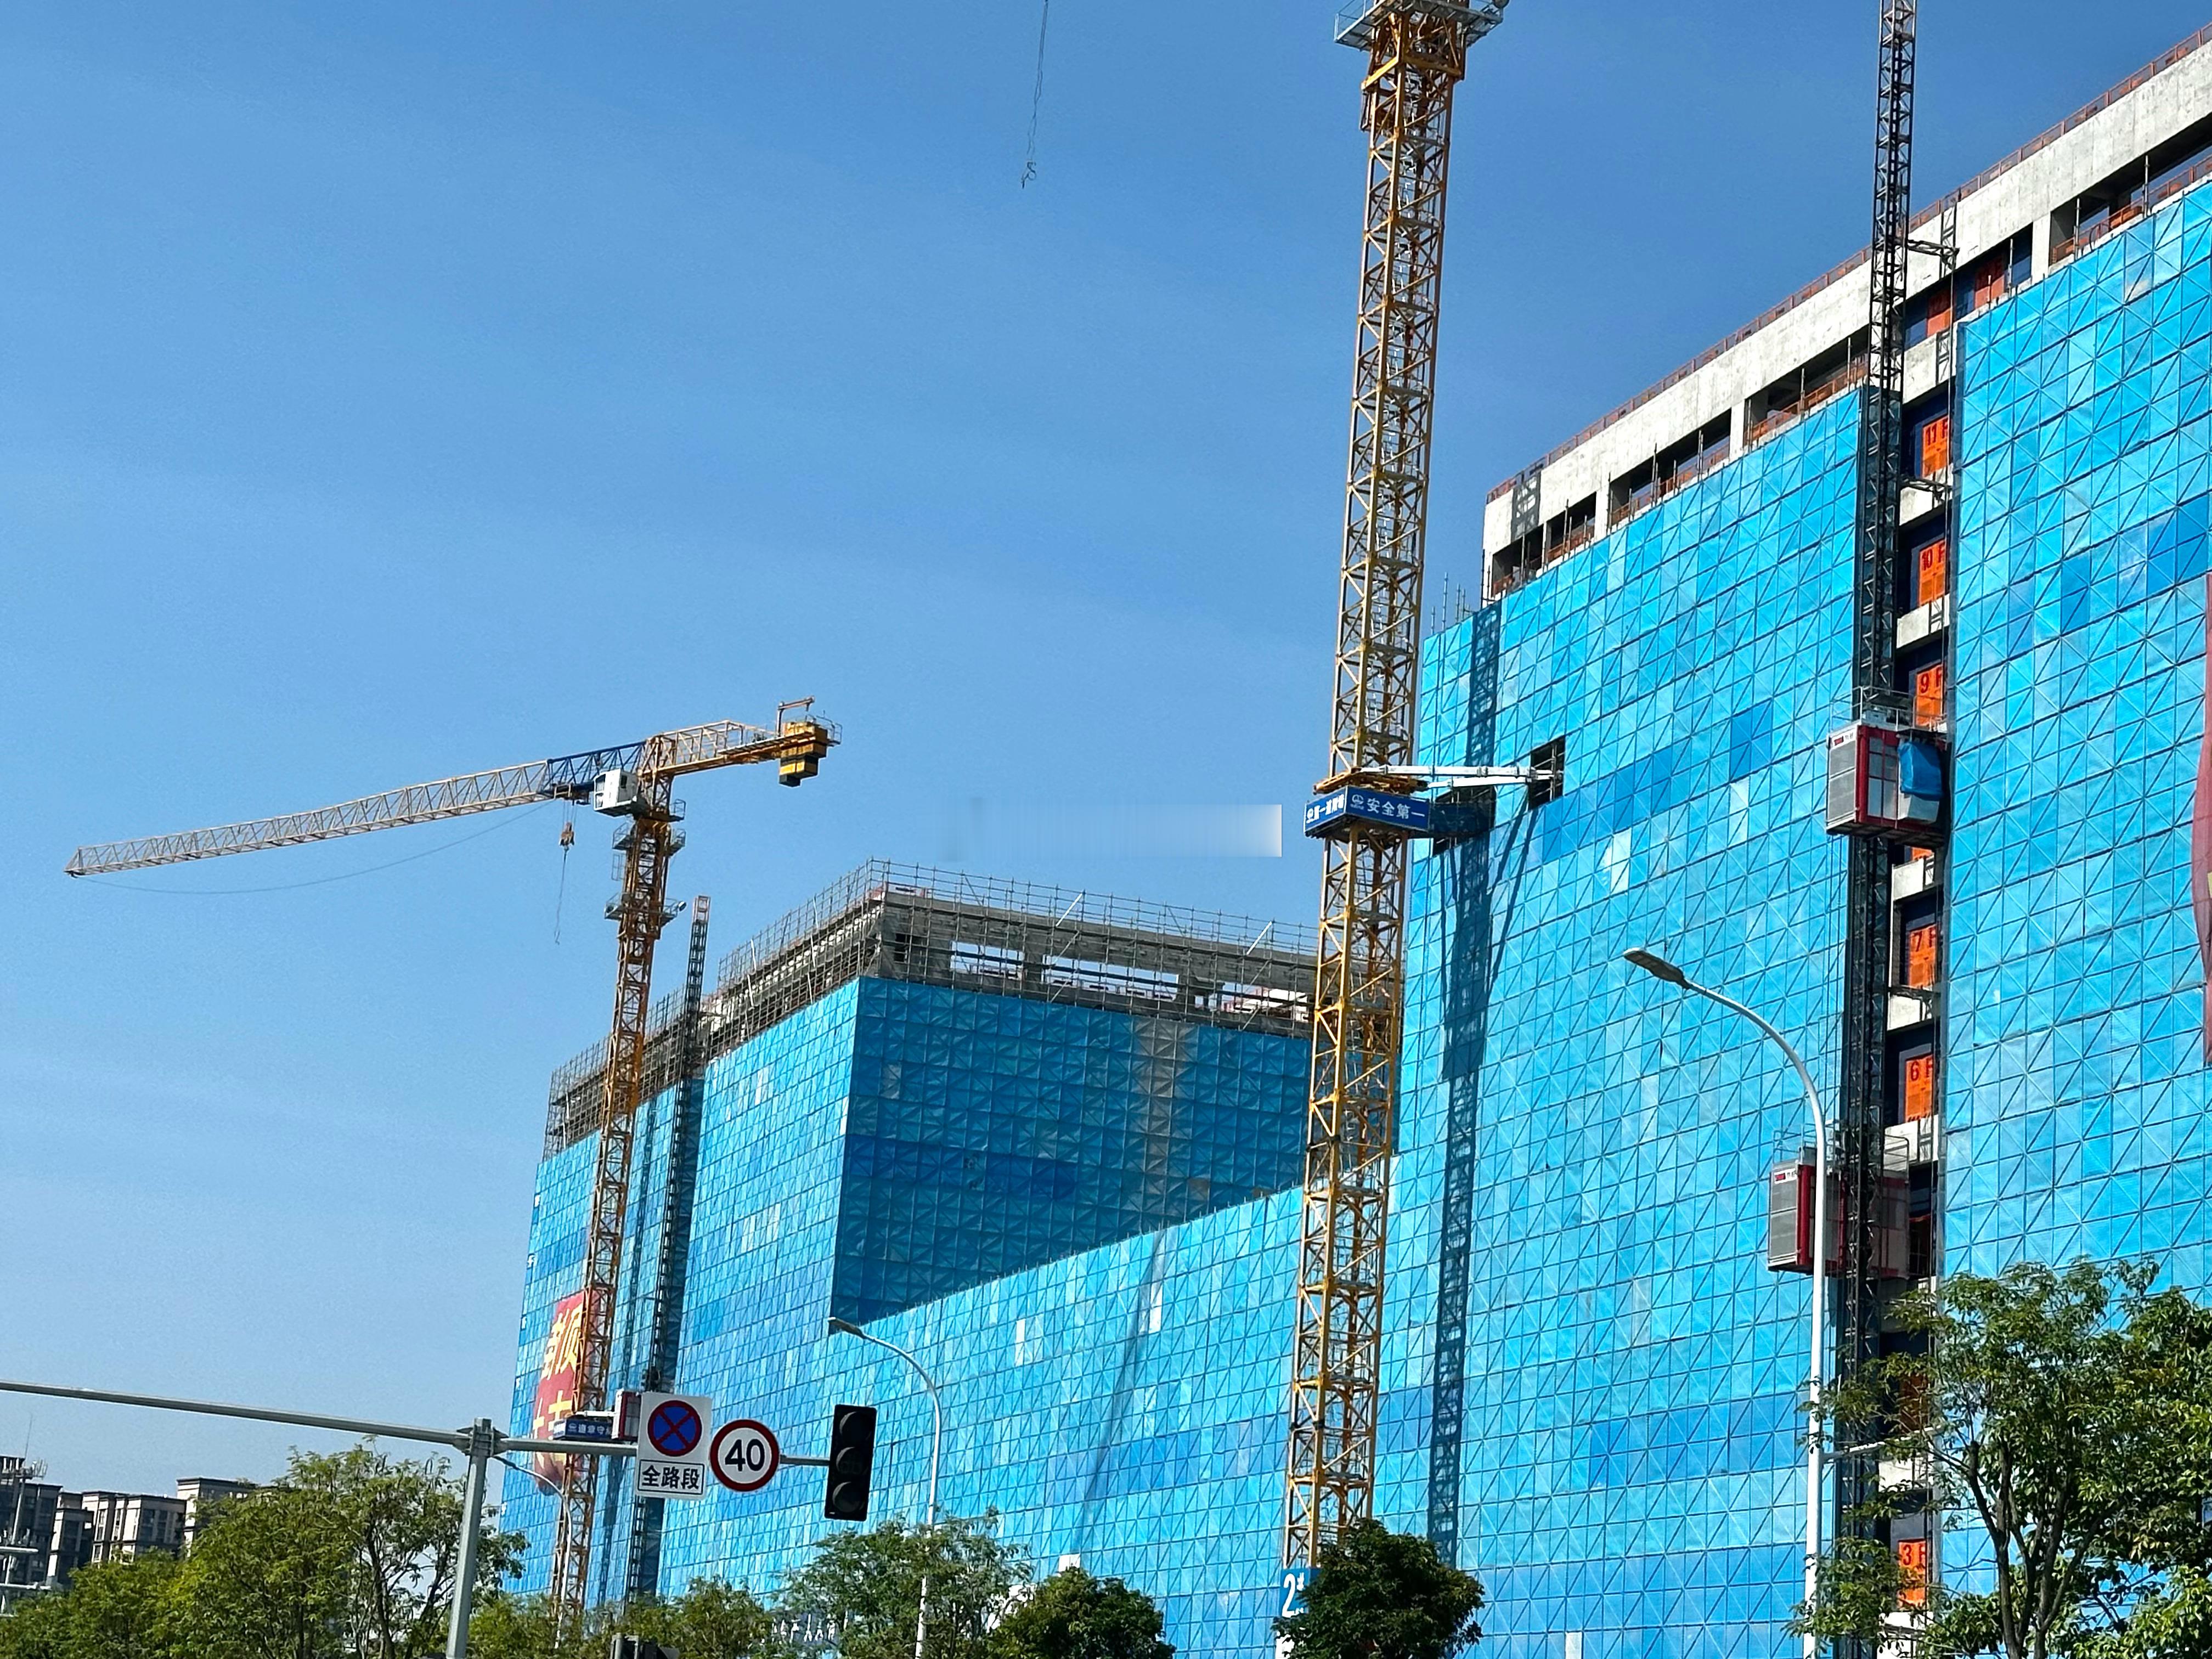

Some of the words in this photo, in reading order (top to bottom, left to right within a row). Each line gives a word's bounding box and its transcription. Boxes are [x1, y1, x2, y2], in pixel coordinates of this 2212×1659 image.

[1367, 797, 1425, 819] 安全第一
[725, 1438, 765, 1472] 40
[642, 1465, 699, 1489] 全路段
